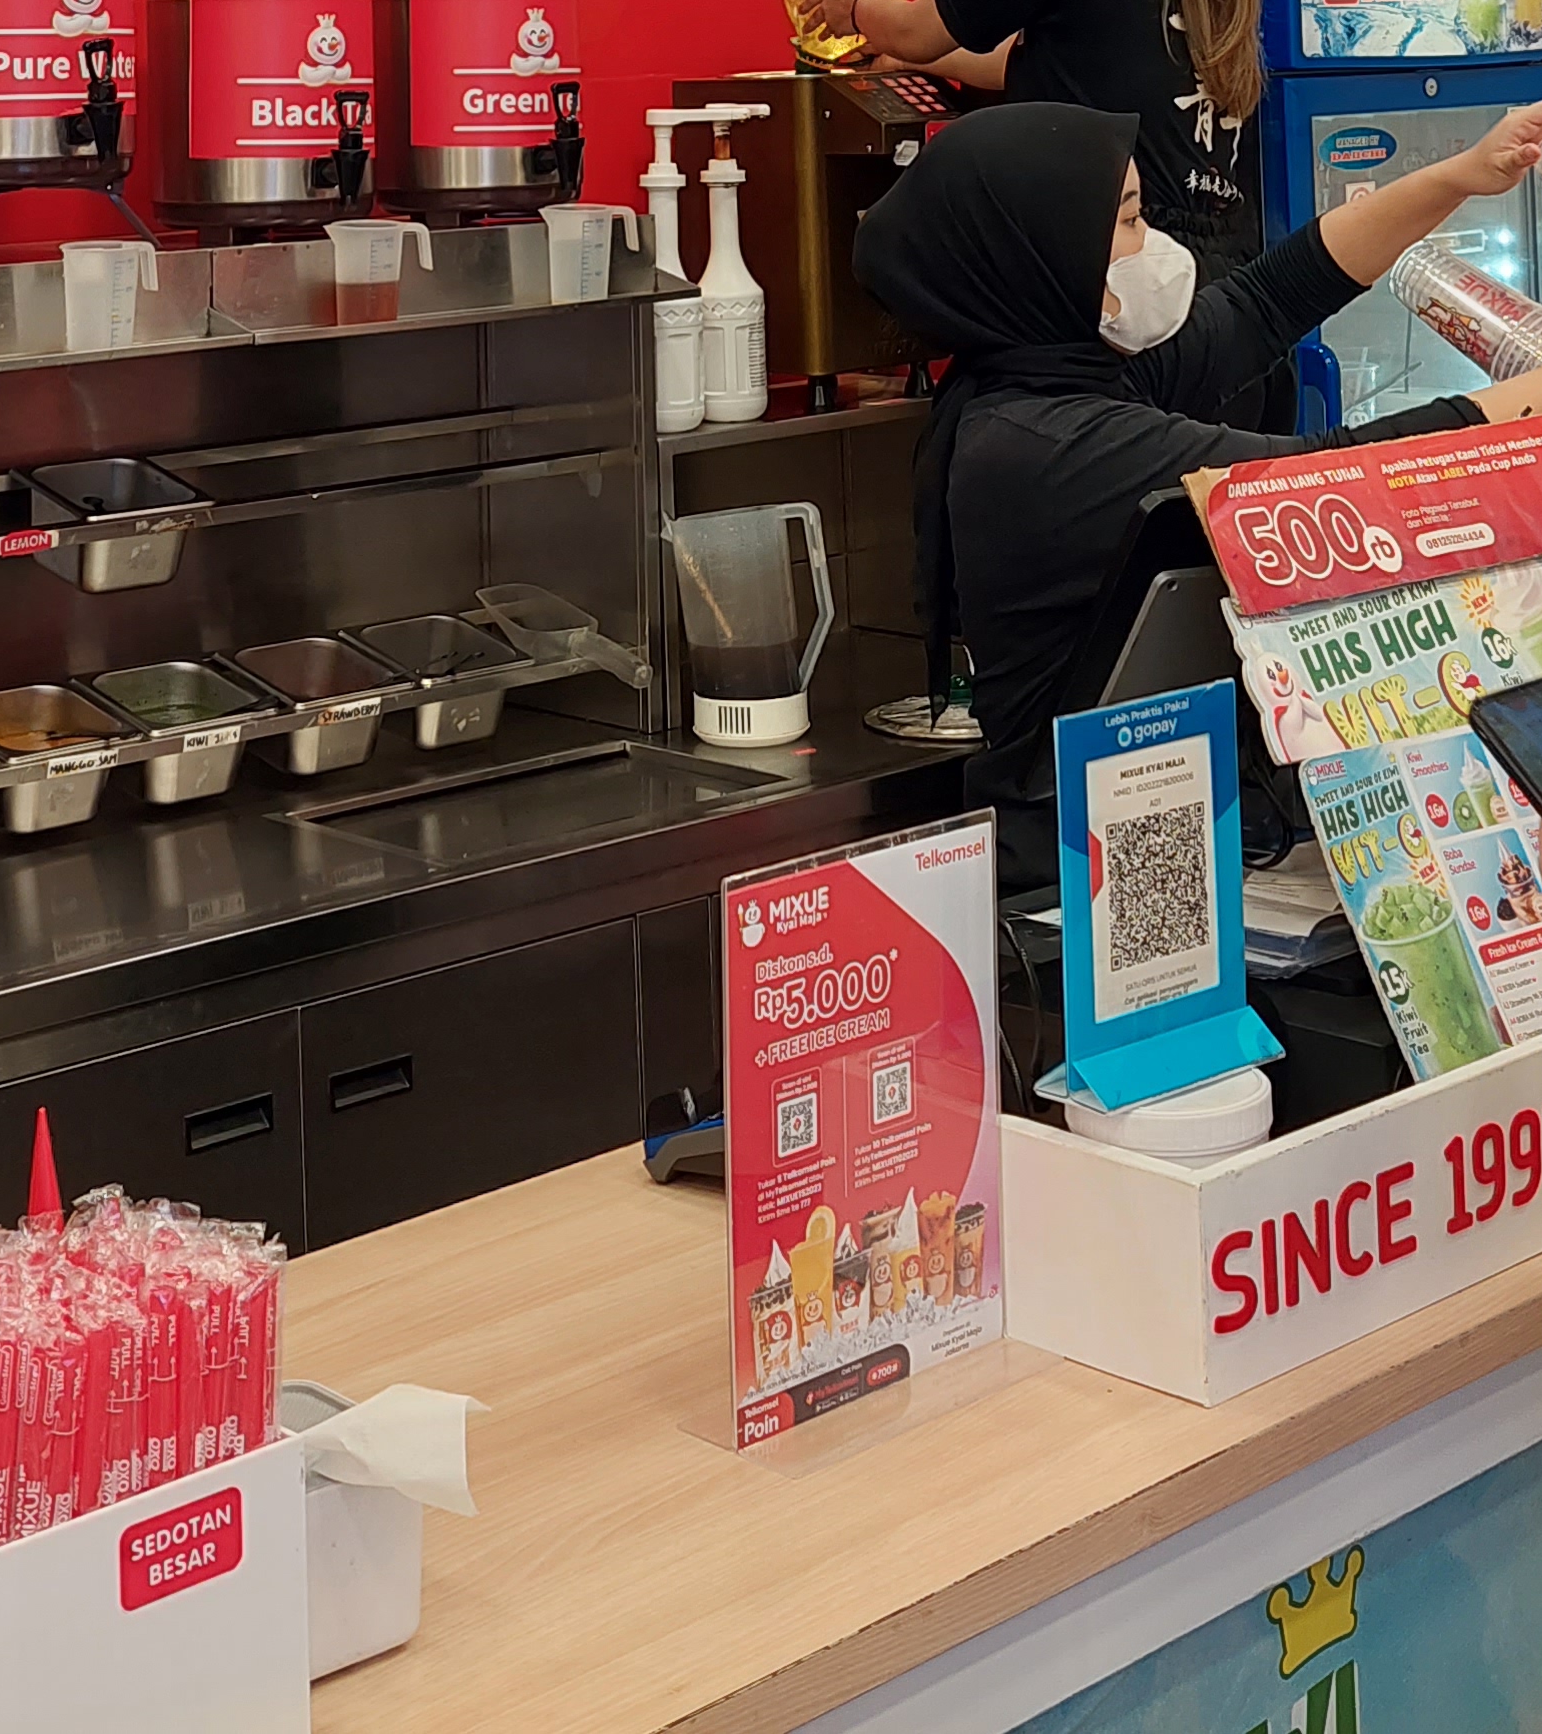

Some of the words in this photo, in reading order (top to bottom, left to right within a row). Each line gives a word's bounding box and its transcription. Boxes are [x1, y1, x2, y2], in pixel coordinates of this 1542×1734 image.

[251, 95, 334, 127] Black
[462, 86, 549, 117] Green
[1381, 459, 1416, 475] Apabila
[1416, 452, 1455, 472] Petugas
[1457, 447, 1478, 461] Kami
[1479, 441, 1507, 456] Tidak
[1388, 475, 1415, 490] NOTA
[1416, 470, 1437, 484] Atau
[1438, 466, 1466, 481] LABEL
[1468, 461, 1490, 476] Pada
[1491, 458, 1509, 474] Cup
[1511, 453, 1536, 467] Anda
[1227, 479, 1289, 498] DAPATKAN
[1291, 472, 1324, 490] UANG
[1324, 466, 1364, 485] TUNAI
[4, 534, 49, 552] LEMON
[1235, 495, 1371, 585] 500
[1371, 535, 1396, 561] rb
[1300, 631, 1372, 692] HAS
[1371, 599, 1457, 668] HIGH
[1106, 712, 1129, 727] Lebih
[1131, 706, 1162, 722] Praktis
[1164, 697, 1189, 714] Pakai
[1134, 718, 1177, 743] gopay
[1120, 767, 1144, 780] MIXUE
[1146, 762, 1164, 774] KYAI
[1165, 757, 1185, 769] MAJA
[1315, 761, 1346, 778] MIXUE
[1411, 762, 1449, 778] Smoothies
[1320, 798, 1360, 840] HAS
[1361, 780, 1409, 823] HIGH
[915, 836, 986, 871] Telkomsel
[769, 886, 829, 924] MIXUE
[756, 952, 805, 983] Diskon
[769, 1038, 809, 1065] FREE
[811, 1025, 834, 1051] ICE
[835, 1008, 890, 1042] CREAM
[1212, 1160, 1418, 1335] SINCE
[744, 1397, 779, 1418] Telkomsel
[744, 1416, 779, 1443] Poin
[131, 1504, 231, 1561] SEDOTAN
[149, 1542, 215, 1585] BESAR
